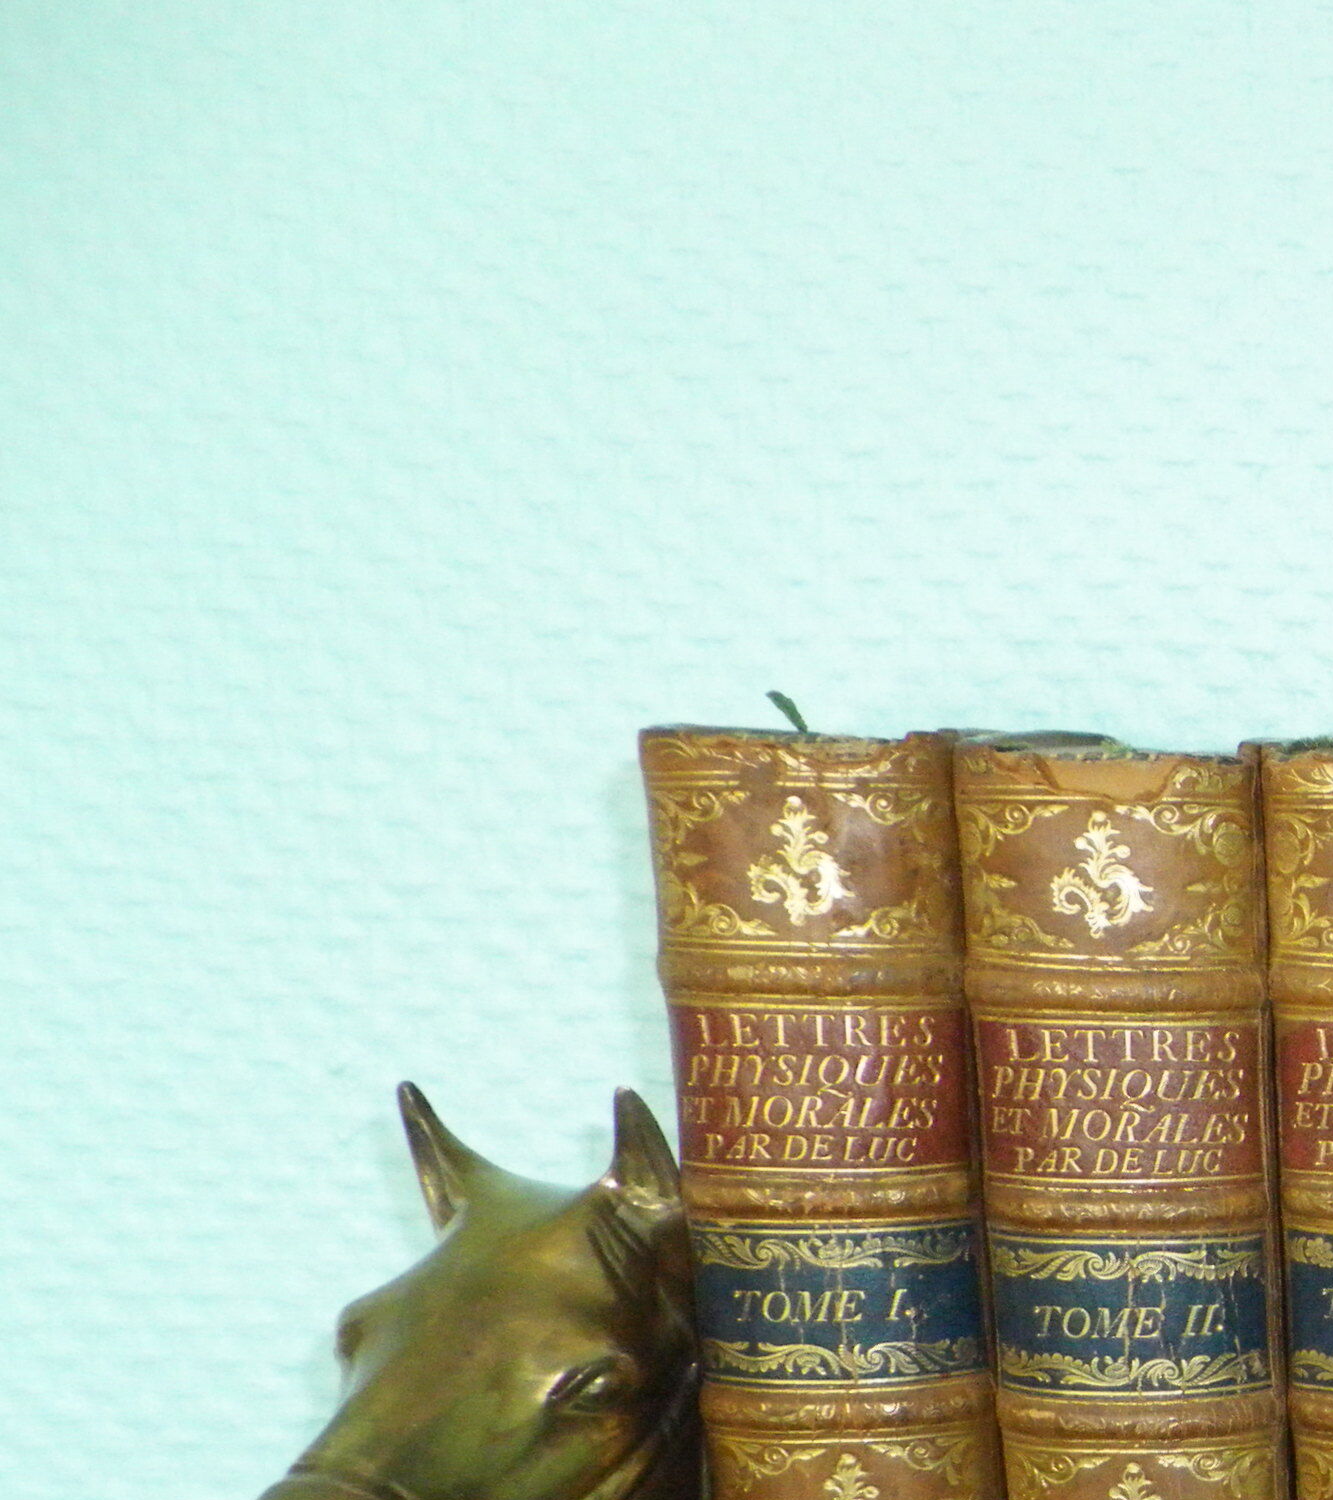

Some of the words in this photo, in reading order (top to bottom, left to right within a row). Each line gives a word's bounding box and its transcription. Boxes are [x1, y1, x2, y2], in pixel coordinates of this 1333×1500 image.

[698, 1013, 935, 1048] LETTRES
[1007, 1029, 1241, 1062] LETTRES
[687, 1054, 943, 1098] PHYSIQUES
[994, 1065, 1243, 1112] PHYSIQUES
[682, 1096, 718, 1128] ET
[725, 1095, 938, 1130] MORALES
[992, 1107, 1030, 1134] ET
[1043, 1106, 1248, 1145] MORALES
[1293, 1103, 1331, 1130] ET
[705, 1133, 772, 1161] PAR
[782, 1133, 831, 1162] DE
[843, 1135, 917, 1163] LUC
[1015, 1147, 1084, 1174] PAR
[1093, 1148, 1141, 1176] DE
[1153, 1148, 1224, 1175] LUC
[734, 1290, 866, 1323] TOME
[1034, 1306, 1163, 1339] TOME
